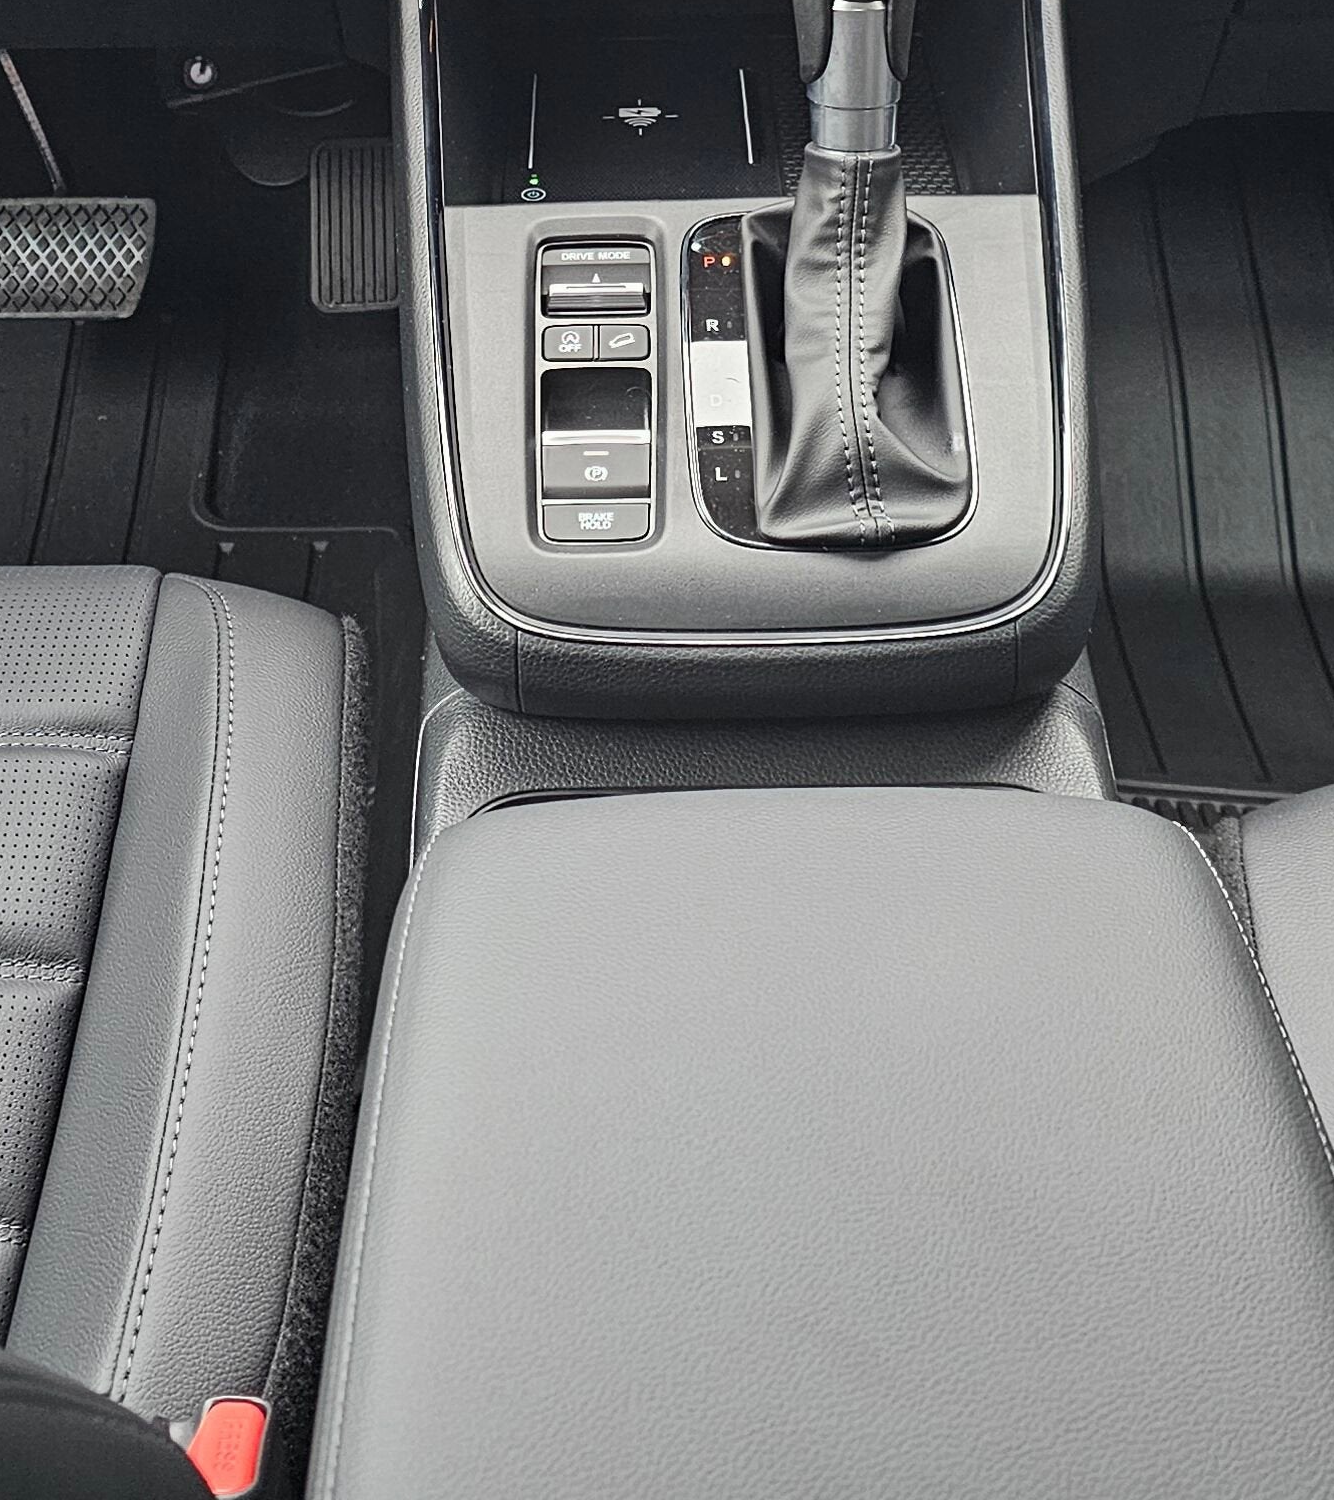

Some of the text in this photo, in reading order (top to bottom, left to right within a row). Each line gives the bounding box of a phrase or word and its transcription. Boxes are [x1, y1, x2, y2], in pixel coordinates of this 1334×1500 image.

[561, 252, 630, 260] DRIVE MODE
[704, 256, 715, 267] P
[705, 319, 719, 332] R
[710, 395, 722, 407] D
[712, 430, 725, 444] S
[715, 467, 727, 481] L
[578, 512, 614, 522] BRAKE
[580, 521, 611, 530] HOLD
